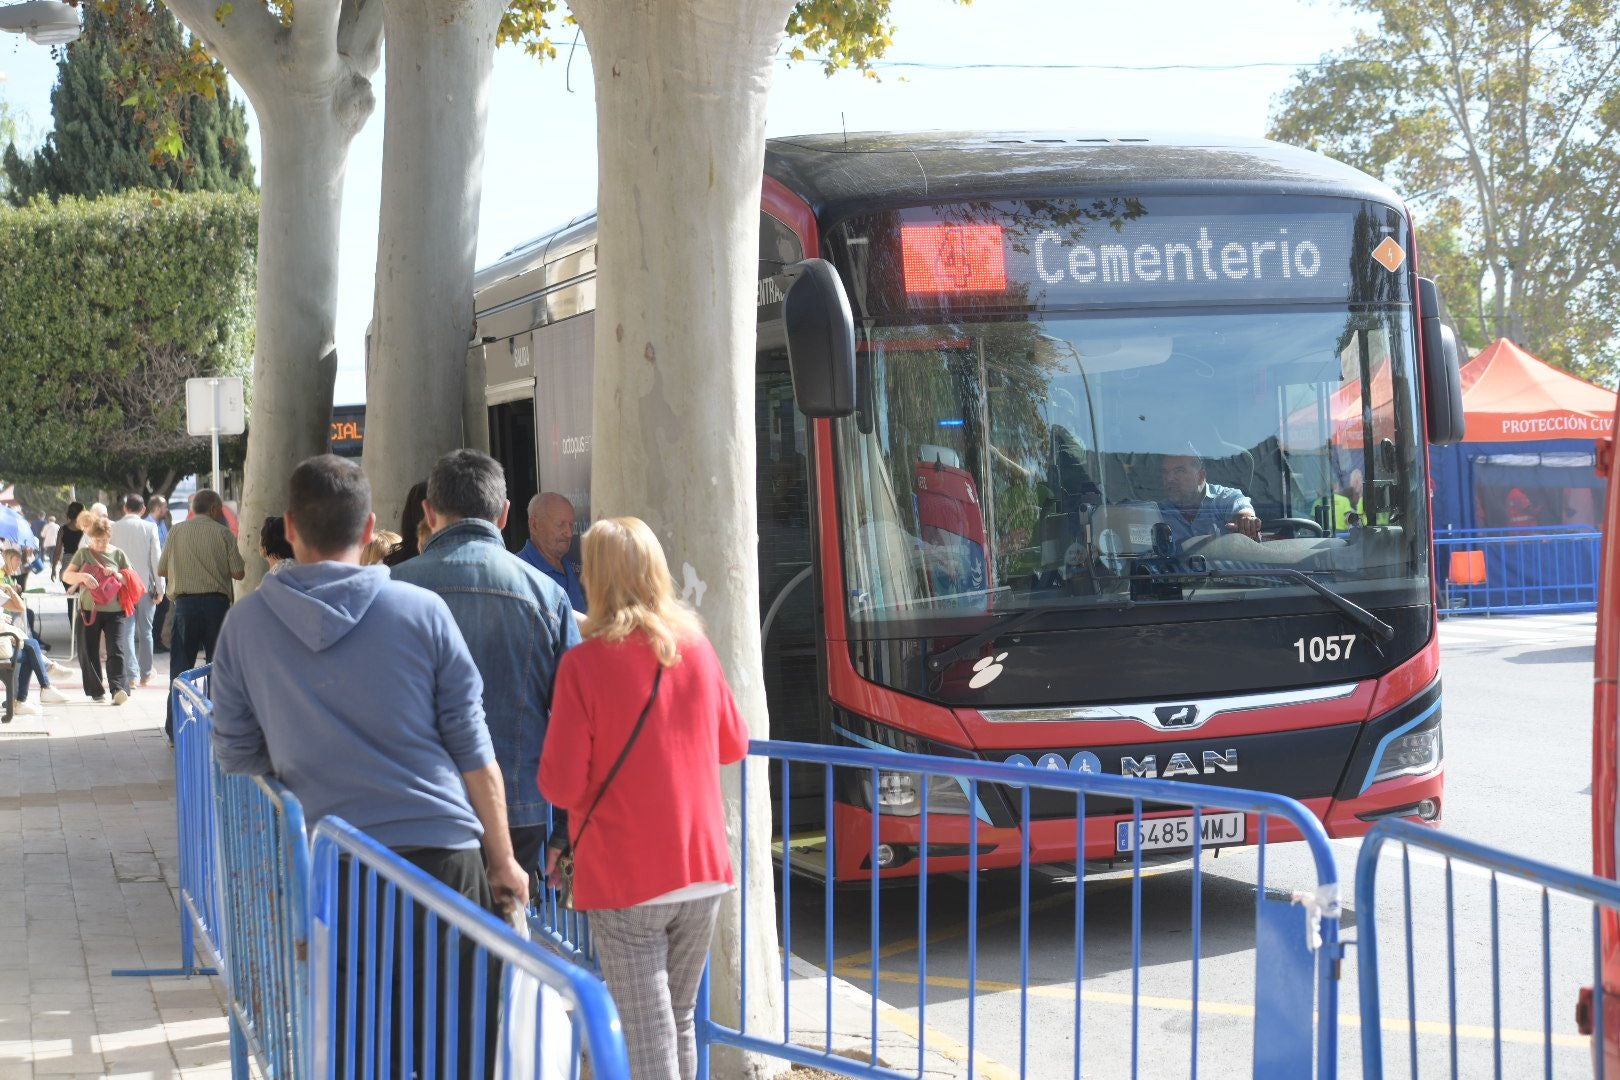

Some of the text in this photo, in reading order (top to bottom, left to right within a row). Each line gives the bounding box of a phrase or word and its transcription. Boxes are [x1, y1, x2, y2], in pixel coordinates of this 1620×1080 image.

[1034, 227, 1320, 284] Cementerio
[758, 277, 785, 306] NTRA
[1502, 415, 1614, 434] PROTECCIÓN CIV
[1293, 634, 1356, 663] 1057
[1121, 749, 1238, 778] MAN
[1200, 817, 1238, 840] MMJ
